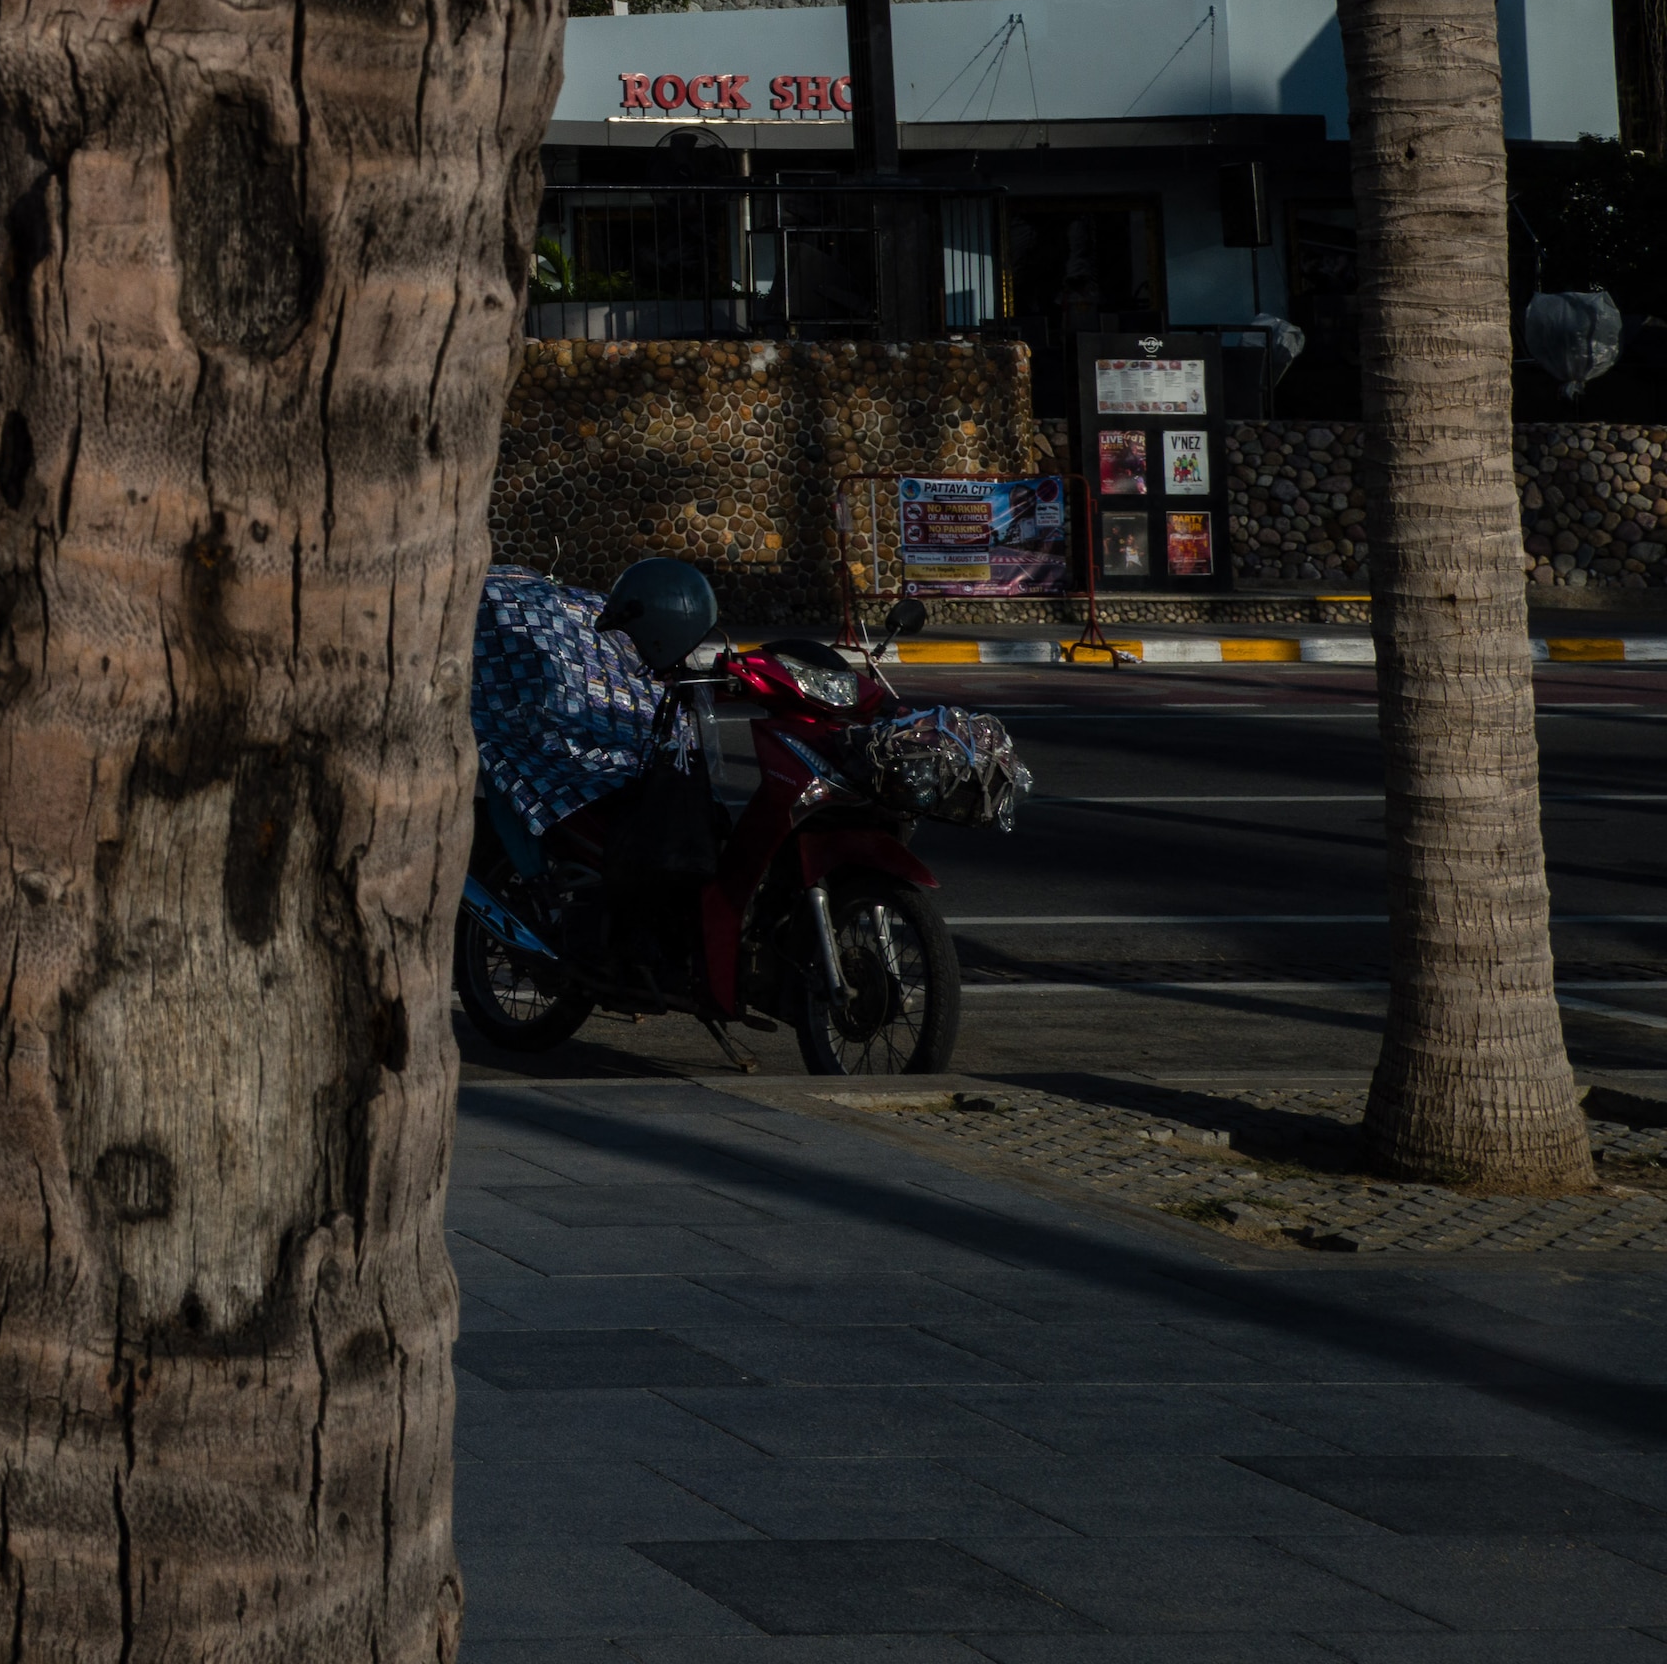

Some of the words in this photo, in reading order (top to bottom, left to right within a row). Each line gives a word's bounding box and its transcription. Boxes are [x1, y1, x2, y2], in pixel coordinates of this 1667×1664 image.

[619, 72, 752, 111] ROCK
[770, 75, 853, 112] SHO
[1101, 436, 1123, 444] LIVE
[924, 483, 968, 494] PATTAYA
[971, 485, 995, 495] CITY
[927, 504, 942, 513] NO
[945, 504, 987, 513] PARKING
[1172, 515, 1204, 523] PARTY
[928, 525, 942, 533] NO
[943, 525, 982, 533] PARKING
